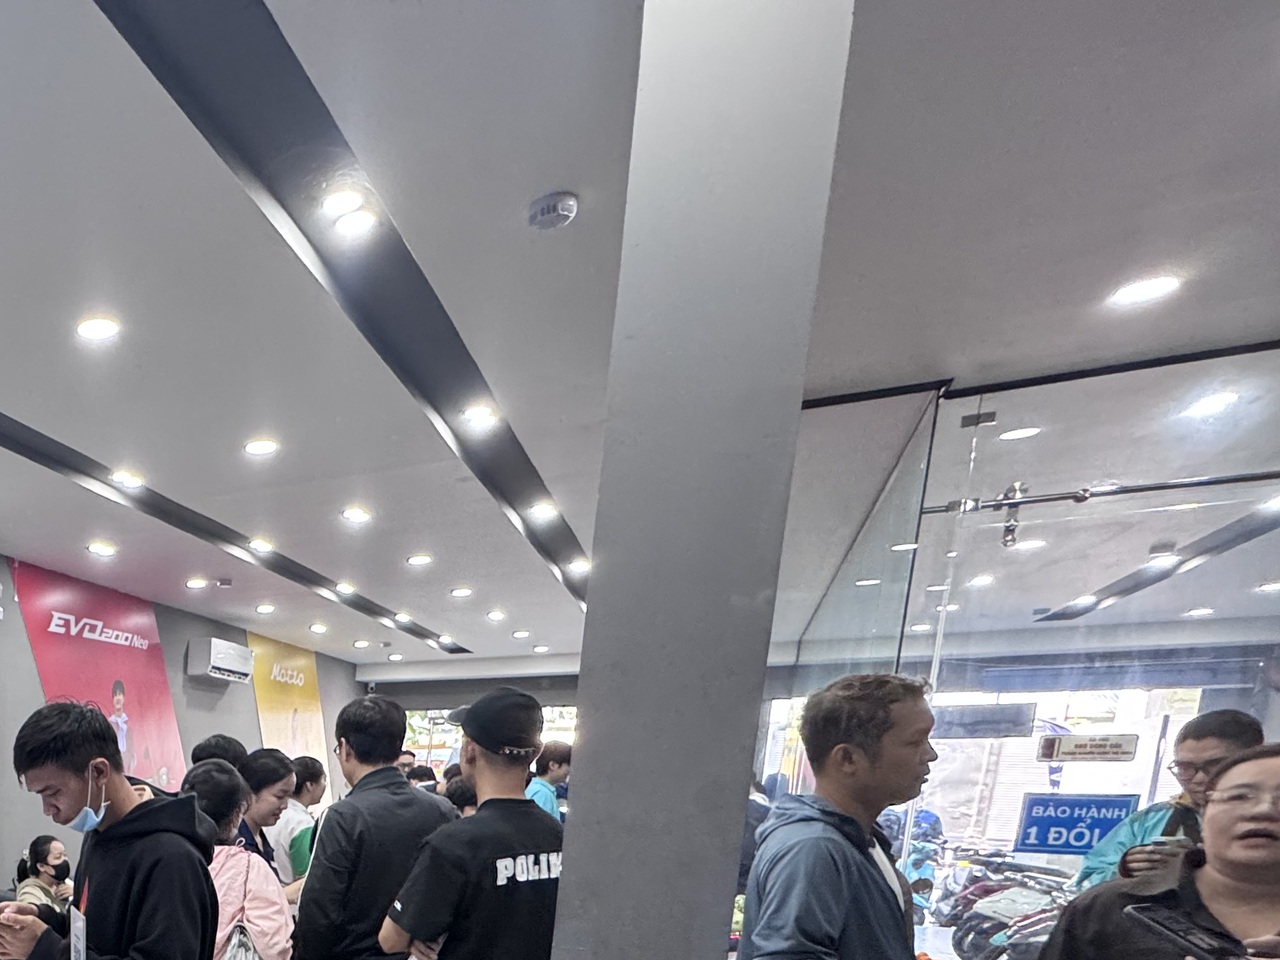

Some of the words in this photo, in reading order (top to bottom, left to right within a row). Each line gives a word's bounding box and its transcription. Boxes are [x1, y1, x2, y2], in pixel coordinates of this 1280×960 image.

[1031, 802, 1071, 818] BẢO
[1073, 804, 1127, 819] HÀNH
[1024, 826, 1039, 844] 1
[1047, 818, 1101, 847] ĐỔI
